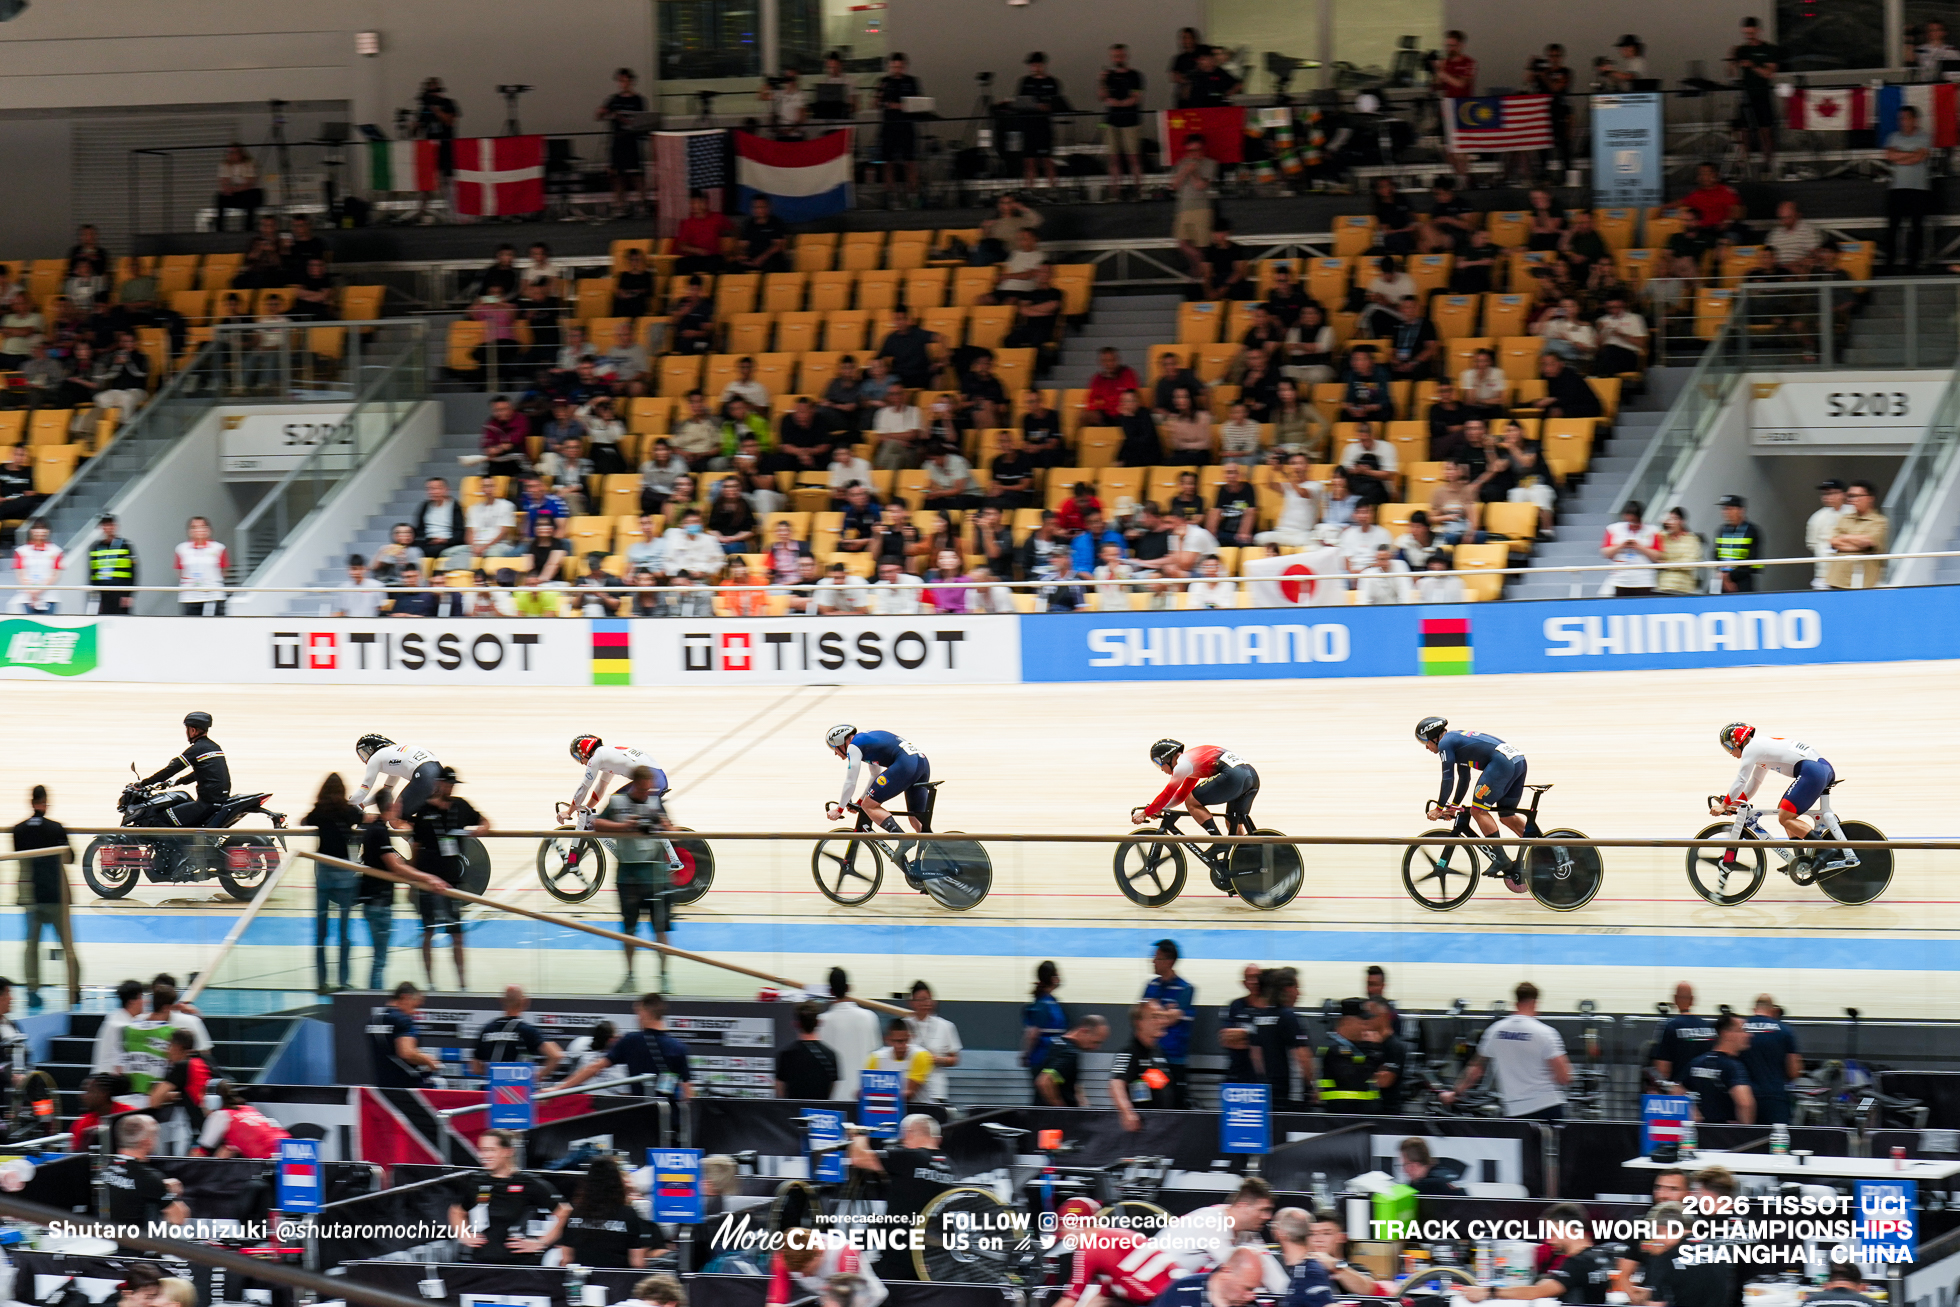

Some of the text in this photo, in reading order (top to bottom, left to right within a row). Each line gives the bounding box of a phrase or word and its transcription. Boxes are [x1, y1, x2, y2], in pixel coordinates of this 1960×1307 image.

[1826, 391, 1911, 417] S203
[1542, 608, 1822, 657] SHIMANO
[348, 632, 541, 671] TISSOT
[763, 630, 966, 670] TISSOT
[1086, 623, 1351, 667] SHIMANO
[1420, 720, 1444, 735] LAZER
[1786, 774, 1802, 796] JAPAN
[861, 1073, 900, 1089] THA
[1222, 1087, 1266, 1104] GRE
[1644, 1098, 1689, 1115] AUT
[651, 1152, 698, 1170] VEN
